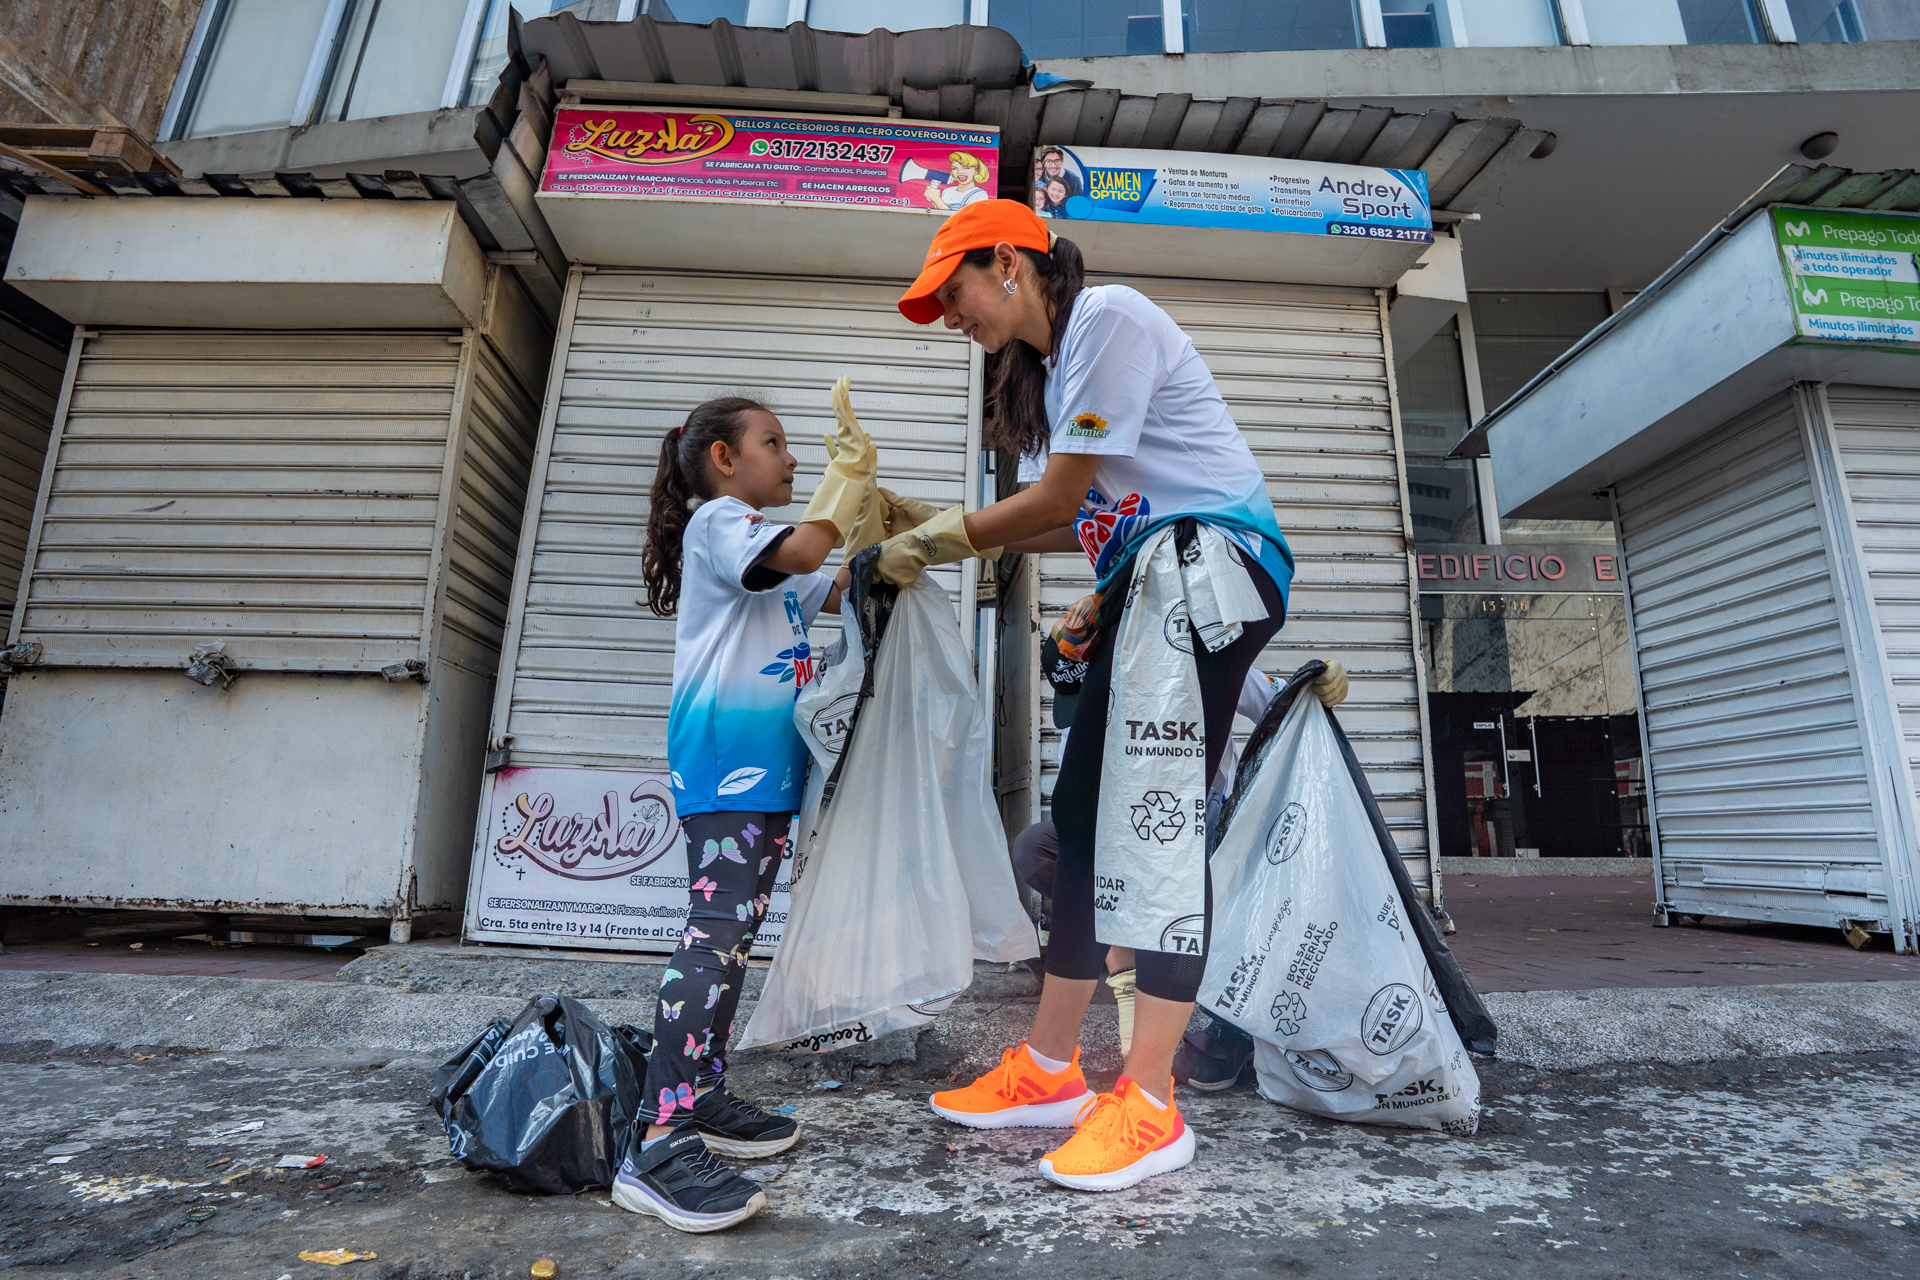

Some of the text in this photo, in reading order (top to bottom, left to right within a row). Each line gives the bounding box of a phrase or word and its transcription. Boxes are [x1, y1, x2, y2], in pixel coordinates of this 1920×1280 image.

[734, 119, 993, 145] BELLOS ACCESORIOS EN ACERO COVERGOLD Y MAS
[769, 139, 896, 164] 3172132437
[705, 161, 715, 169] SE
[715, 161, 755, 170] FABRICAN
[773, 164, 802, 172] GUSTO:
[855, 168, 887, 176] Pulseras
[1168, 167, 1189, 176] Ventas
[1200, 169, 1228, 179] Monturas
[568, 173, 629, 181] PERSONALIZAN
[706, 177, 731, 185] Anillos
[732, 178, 766, 187] Pulseras
[813, 183, 844, 191] HACEN
[845, 184, 891, 193] ARREGLOS
[1090, 170, 1142, 192] EXAMEN
[1168, 178, 1186, 186] Gafas
[1197, 181, 1224, 189] aumento
[1230, 182, 1240, 190] sol
[1273, 175, 1310, 186] Progresivo
[596, 185, 627, 193] entre
[628, 185, 640, 193] 13
[642, 186, 650, 195] y
[651, 186, 664, 194] 14
[666, 186, 707, 196] (Frente
[721, 189, 769, 198] Calzado
[770, 191, 854, 204] Bucaramanga
[867, 196, 879, 204] 13
[1090, 189, 1141, 201] OPTICO
[1169, 189, 1189, 197] Lentes
[1228, 193, 1251, 202] medica
[1273, 186, 1312, 196] Transitions
[1318, 176, 1402, 203] Andrey
[1169, 200, 1204, 210] Reparamos
[1205, 202, 1219, 210] toda
[1220, 204, 1237, 212] clase
[1247, 205, 1265, 214] gafas
[1275, 207, 1324, 219] Policarbonato
[1343, 197, 1413, 219] Sport
[1342, 225, 1427, 241] 320 682 2177
[1822, 224, 1887, 247] Prepago
[1792, 249, 1898, 266] Minutos ilimitados
[1803, 262, 1893, 277] a todo operador
[1840, 291, 1905, 315] Prepago
[1808, 318, 1914, 336] Minutos ilimitados
[1066, 419, 1110, 439] Premier
[1417, 554, 1623, 581] EDIFICIO E
[1482, 600, 1496, 612] 13
[1510, 601, 1528, 612] 46
[1125, 746, 1143, 757] UN
[1146, 746, 1193, 758] MUNDO
[630, 875, 690, 888] SE FABRICAN
[487, 897, 499, 908] SE
[499, 898, 564, 912] PERSONALIZAN
[564, 901, 573, 913] Y
[648, 906, 676, 918] Anillos
[481, 917, 506, 928] Cra.
[509, 918, 528, 929] 5ta
[531, 921, 563, 931] entre
[565, 921, 577, 932] 13
[579, 924, 587, 936] y
[589, 923, 602, 934] 14
[605, 922, 647, 936] (Frente
[651, 927, 663, 937] al
[1286, 922, 1317, 982] BOLSA DE
[1295, 927, 1326, 986] MATERIAL
[1302, 921, 1338, 990] RECICLADO
[1233, 1003, 1245, 1018] UN
[1240, 966, 1261, 1004] MUNDO
[1257, 953, 1266, 967] DE
[1375, 1078, 1444, 1104] TSK,
[1392, 1096, 1435, 1110] MUNDO
[1437, 1092, 1451, 1102] DE
